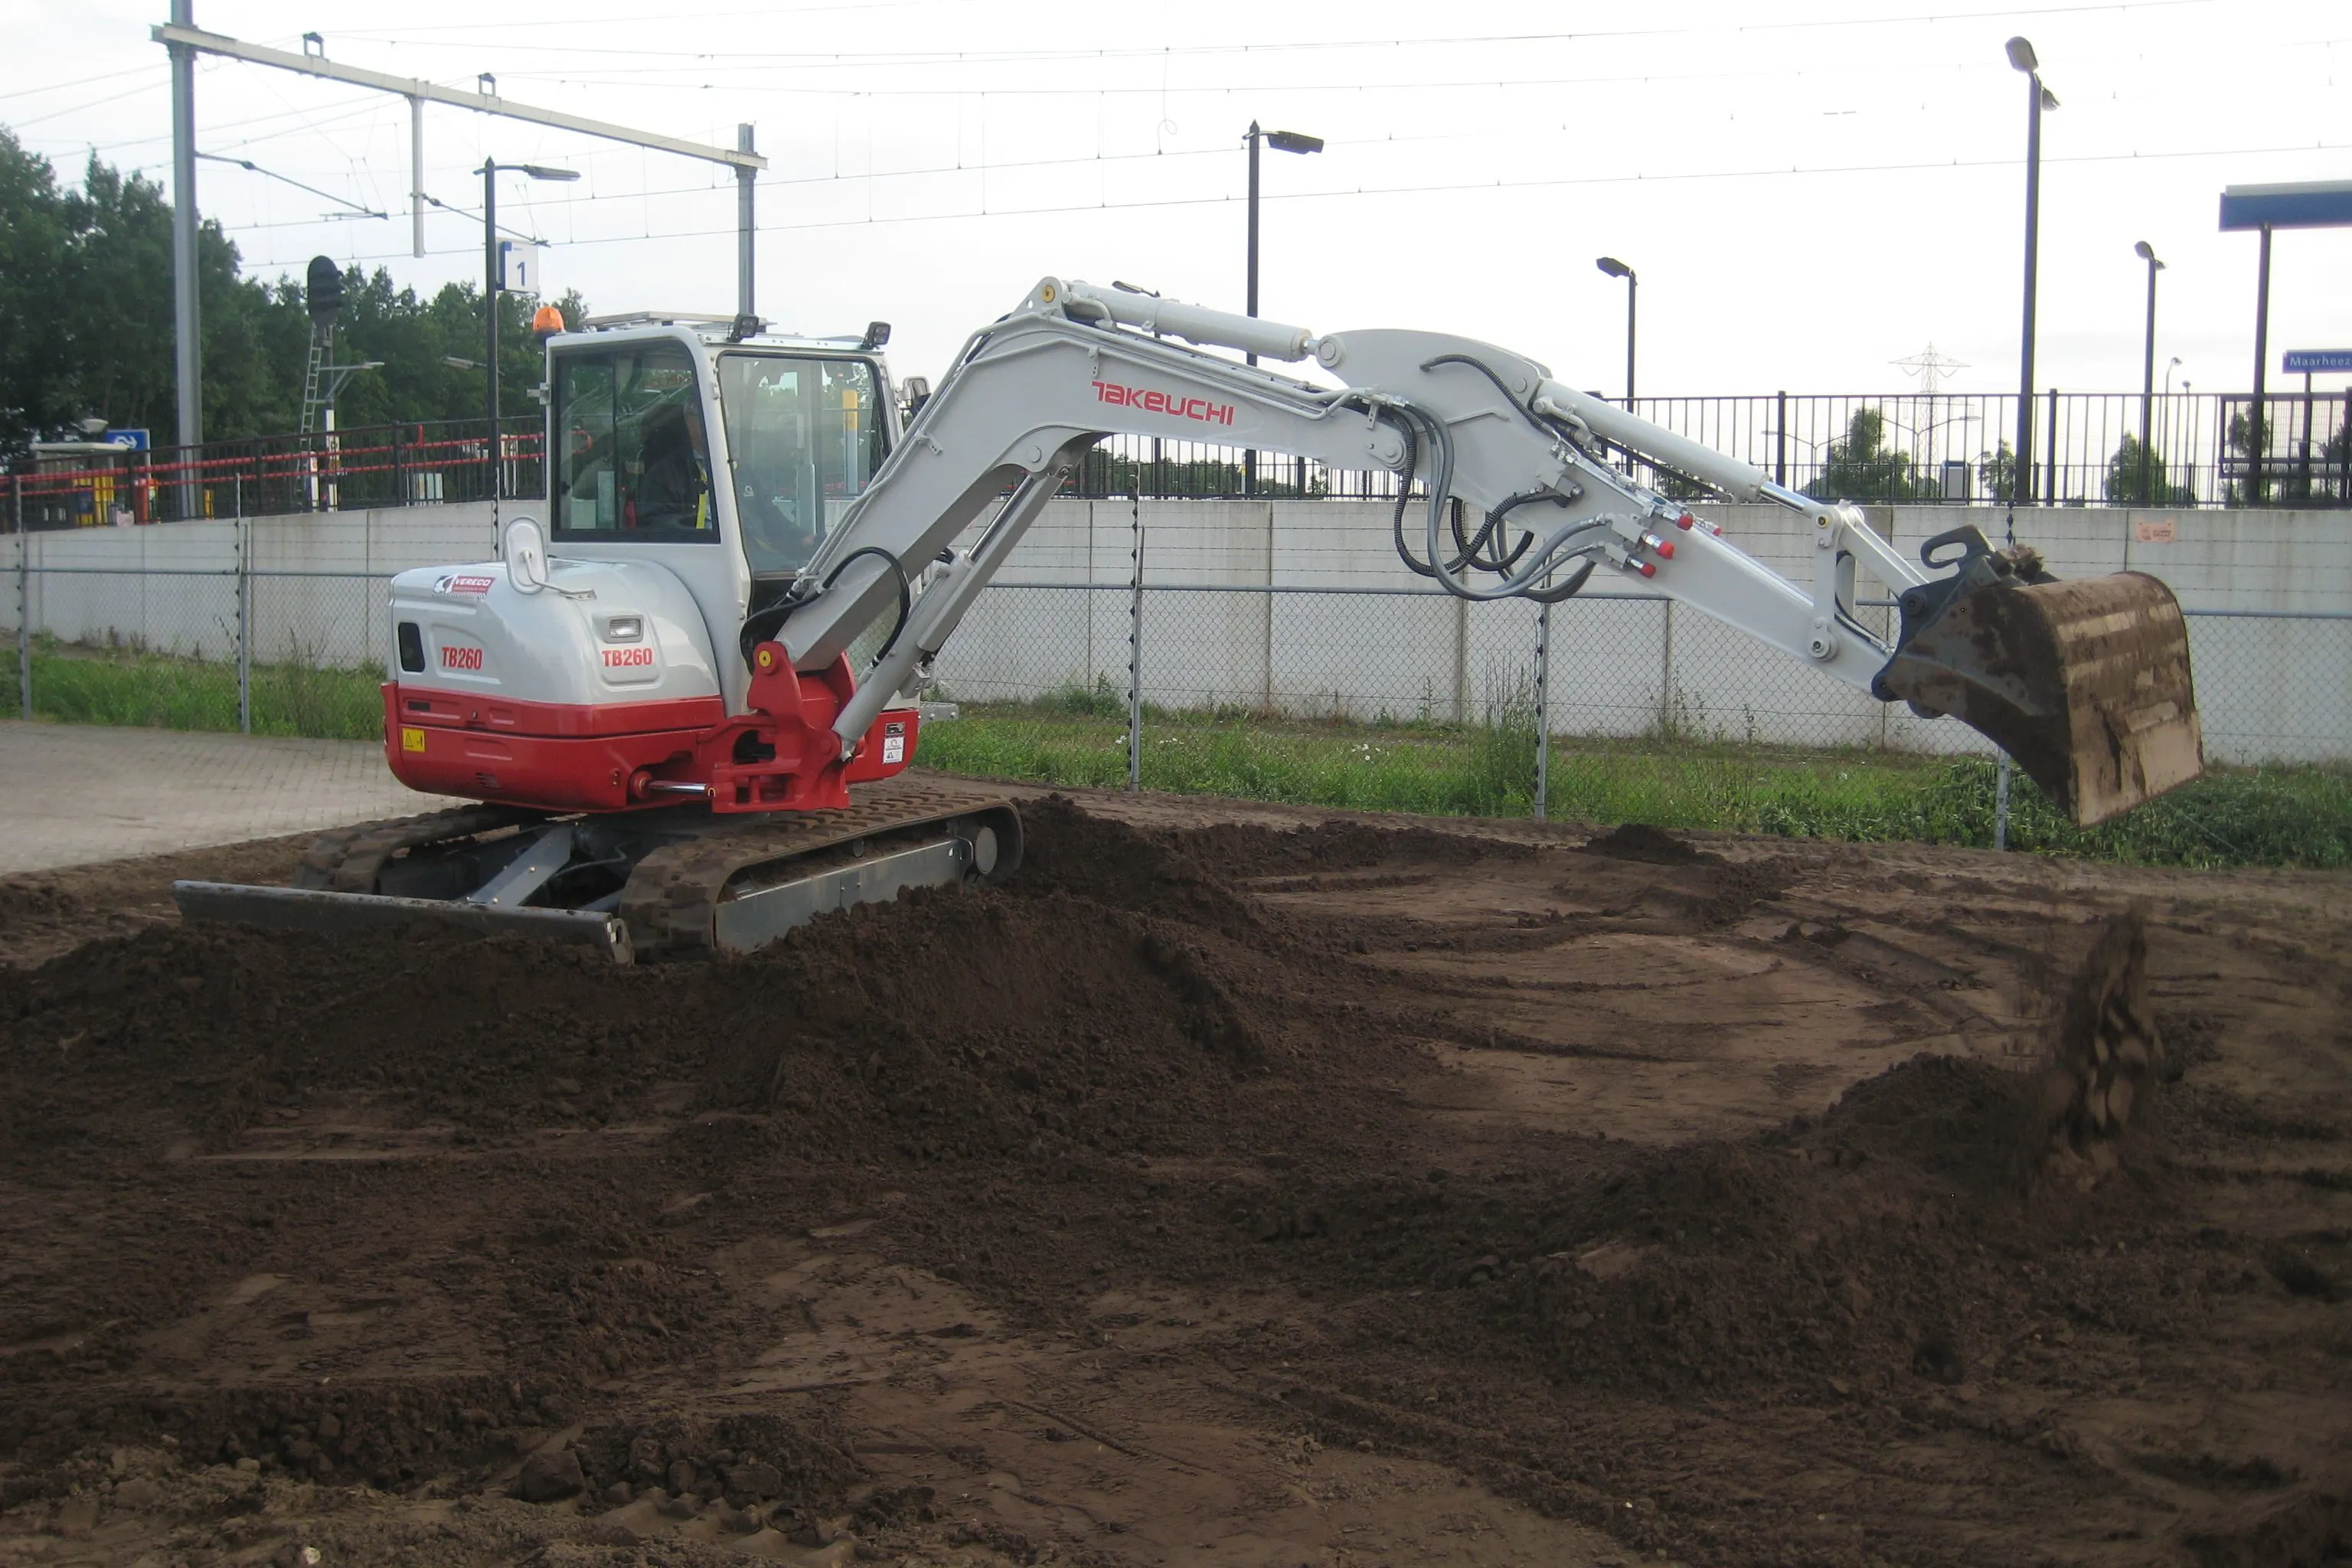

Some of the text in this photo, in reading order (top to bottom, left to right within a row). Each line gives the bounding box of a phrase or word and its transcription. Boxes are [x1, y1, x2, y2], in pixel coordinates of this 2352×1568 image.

[517, 262, 525, 286] 1
[442, 646, 482, 669] TB260
[602, 648, 653, 667] TB260
